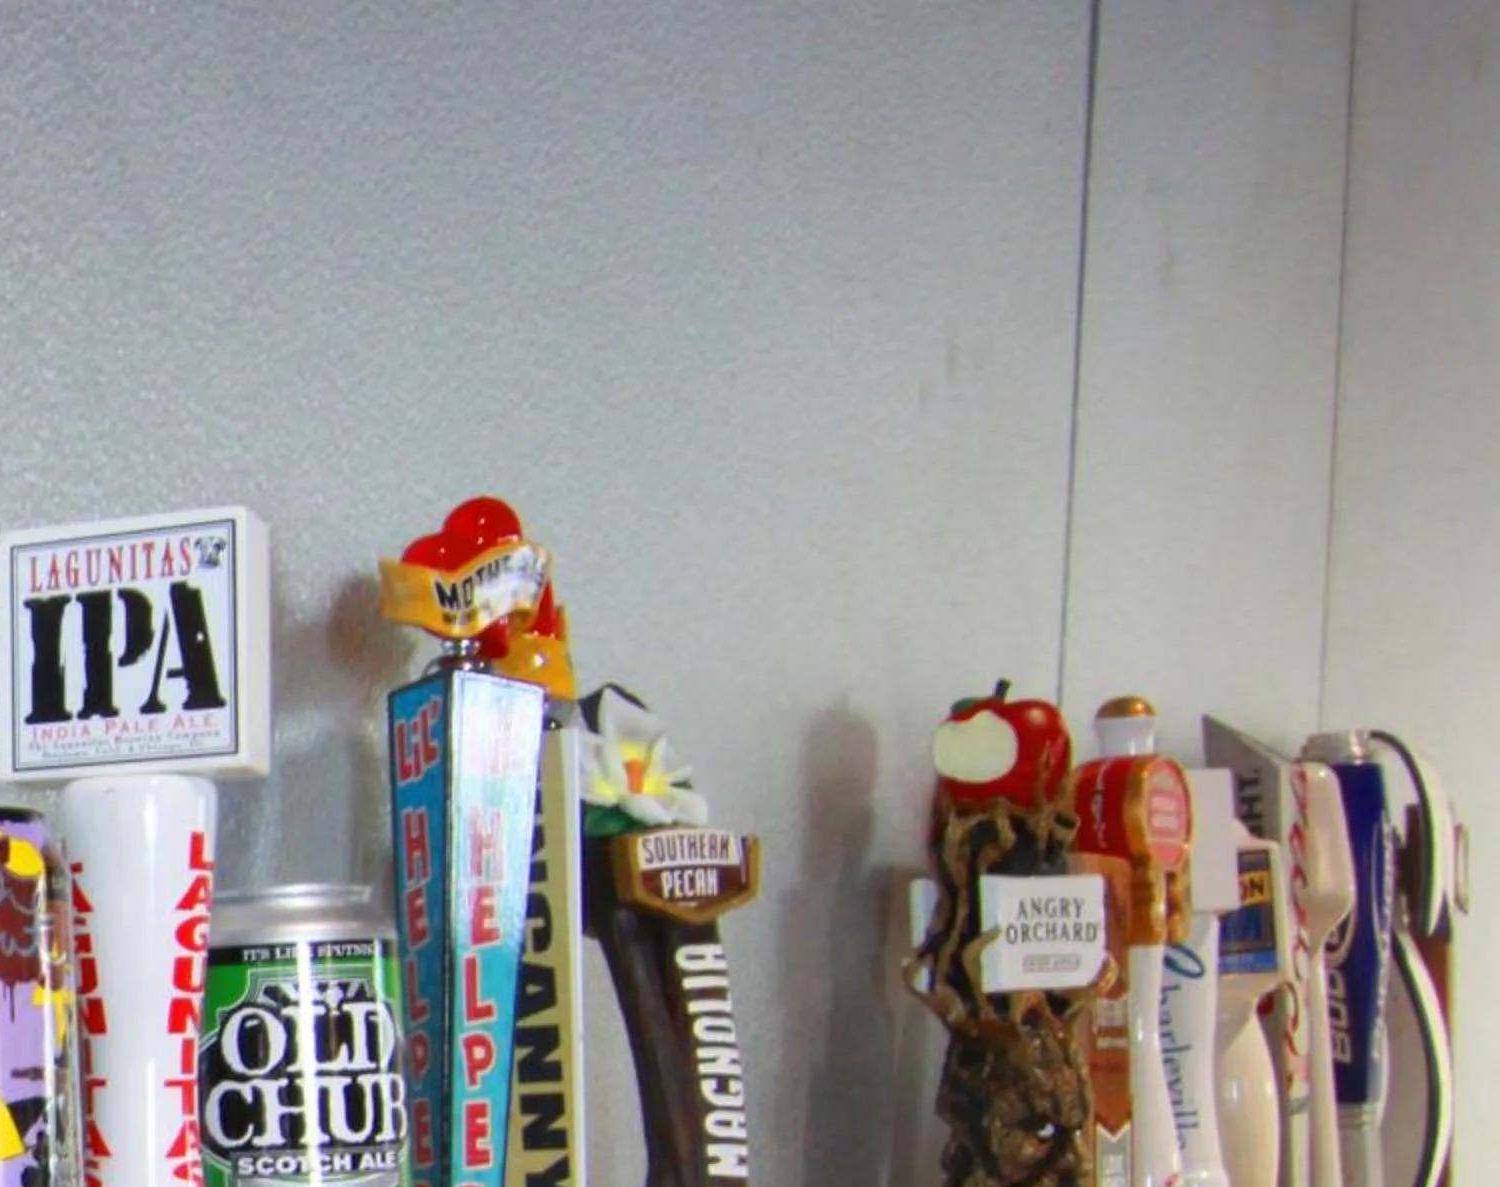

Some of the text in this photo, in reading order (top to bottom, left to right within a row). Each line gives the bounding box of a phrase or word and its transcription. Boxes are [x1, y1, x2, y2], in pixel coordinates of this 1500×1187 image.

[29, 536, 195, 594] LAGUNITAS
[23, 580, 228, 725] IPA
[32, 713, 218, 742] INDIA PALE ALE
[661, 867, 719, 899] PECAN
[1018, 896, 1086, 920] ANGRY
[1005, 922, 1099, 945] ORCHARD
[221, 1001, 397, 1076] OLD
[674, 942, 749, 1178] MAGNOLIA
[204, 1073, 408, 1148] CHUB
[237, 1151, 397, 1176] SCOTCH ALE
